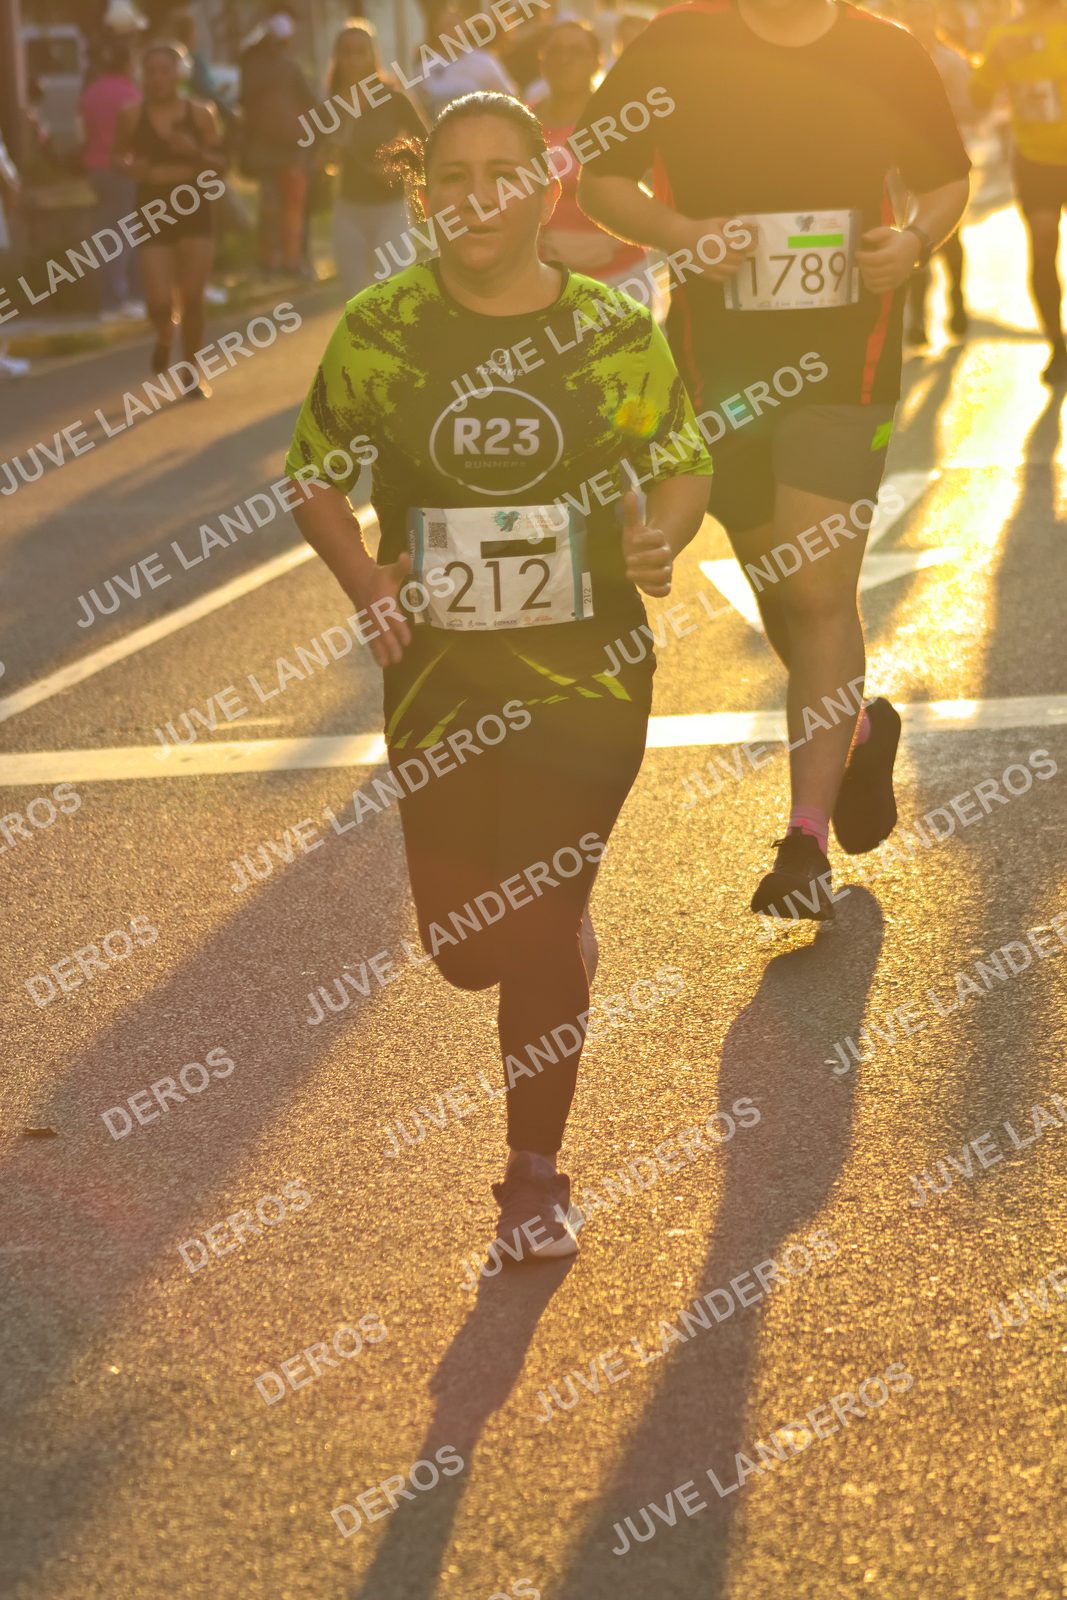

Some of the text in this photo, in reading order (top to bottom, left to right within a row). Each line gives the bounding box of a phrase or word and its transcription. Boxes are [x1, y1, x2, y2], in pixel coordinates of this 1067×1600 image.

[747, 251, 847, 297] 1789
[453, 417, 540, 456] R23
[443, 558, 552, 613] 212
